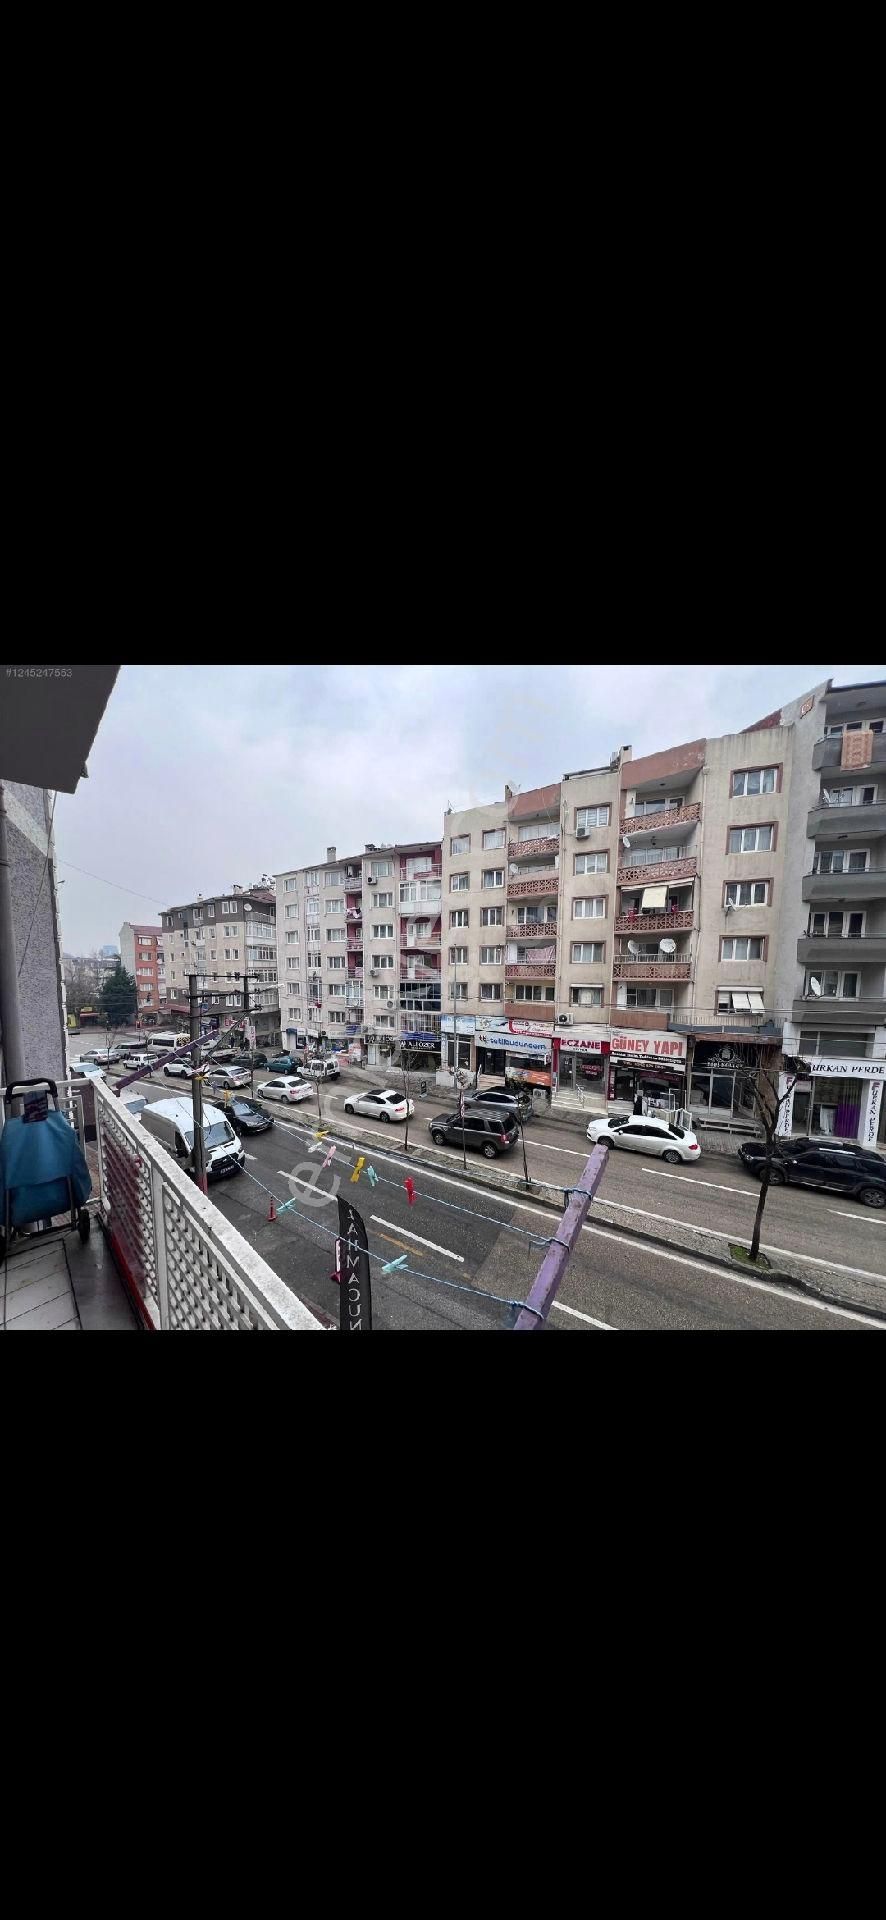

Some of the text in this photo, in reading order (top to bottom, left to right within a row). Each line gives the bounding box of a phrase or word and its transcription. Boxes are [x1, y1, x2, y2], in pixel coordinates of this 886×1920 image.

[560, 1039, 601, 1050] ECZANE
[611, 1035, 650, 1052] GÜNEY
[653, 1040, 684, 1057] YAPI
[811, 1064, 885, 1074] URKAN PERDE
